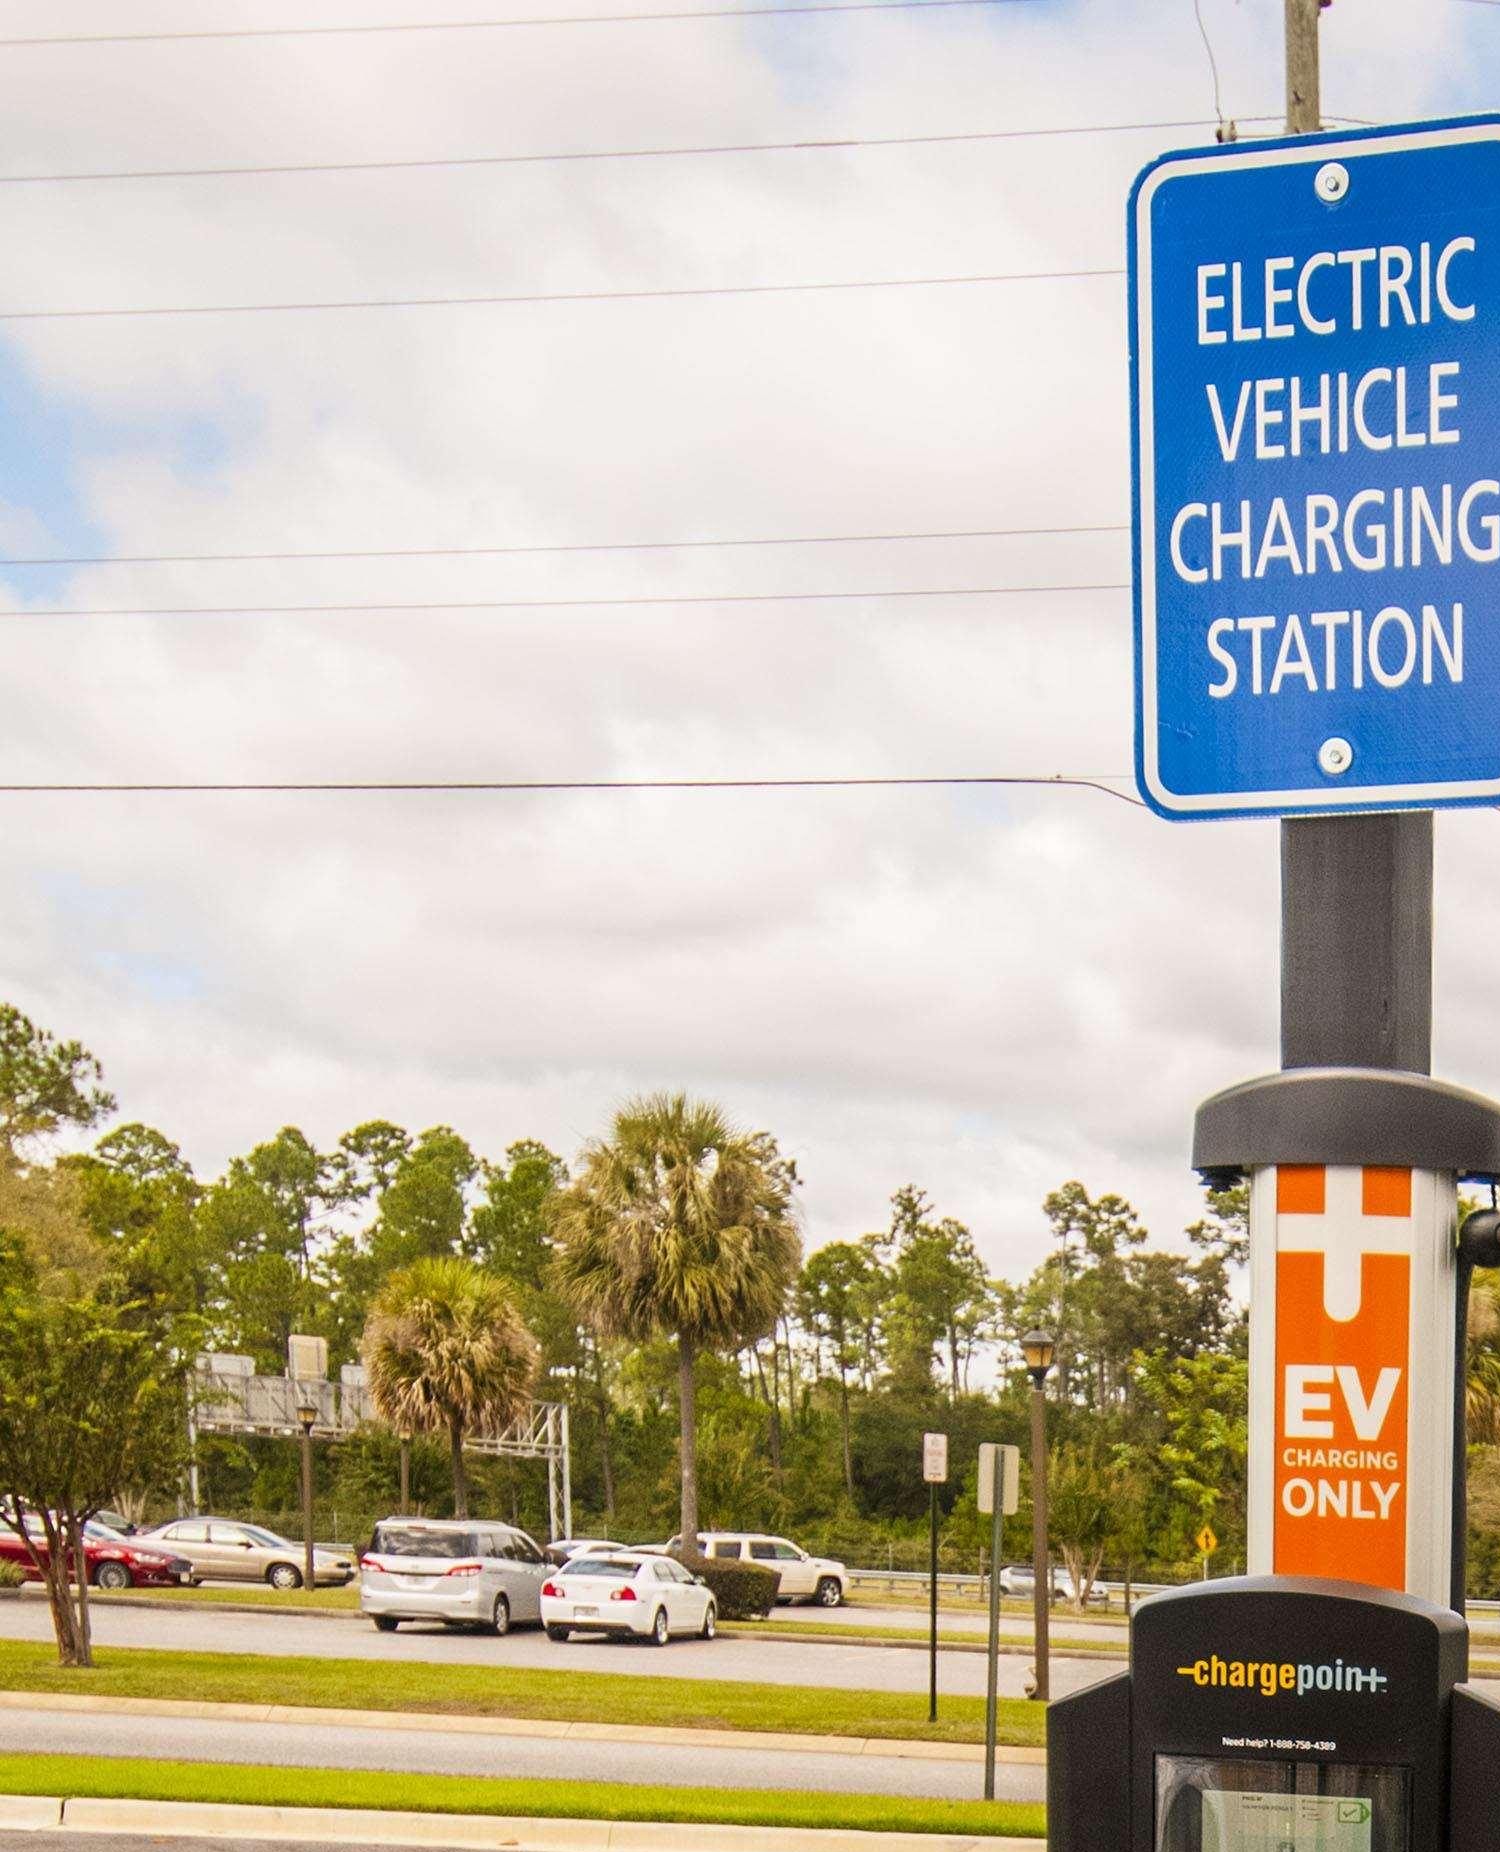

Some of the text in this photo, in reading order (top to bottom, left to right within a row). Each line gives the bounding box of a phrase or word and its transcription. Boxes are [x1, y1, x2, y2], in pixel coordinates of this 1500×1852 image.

[1197, 236, 1476, 345] ELECTRIC
[1205, 361, 1460, 463] VEHICLE
[1169, 479, 1500, 584] CHARGING
[1206, 602, 1464, 699] STATION
[1284, 1364, 1402, 1442] EV
[1281, 1477, 1402, 1520] ONLY
[1282, 1447, 1398, 1471] CHARGING
[1222, 1736, 1245, 1747] Need
[1246, 1738, 1269, 1749] help?
